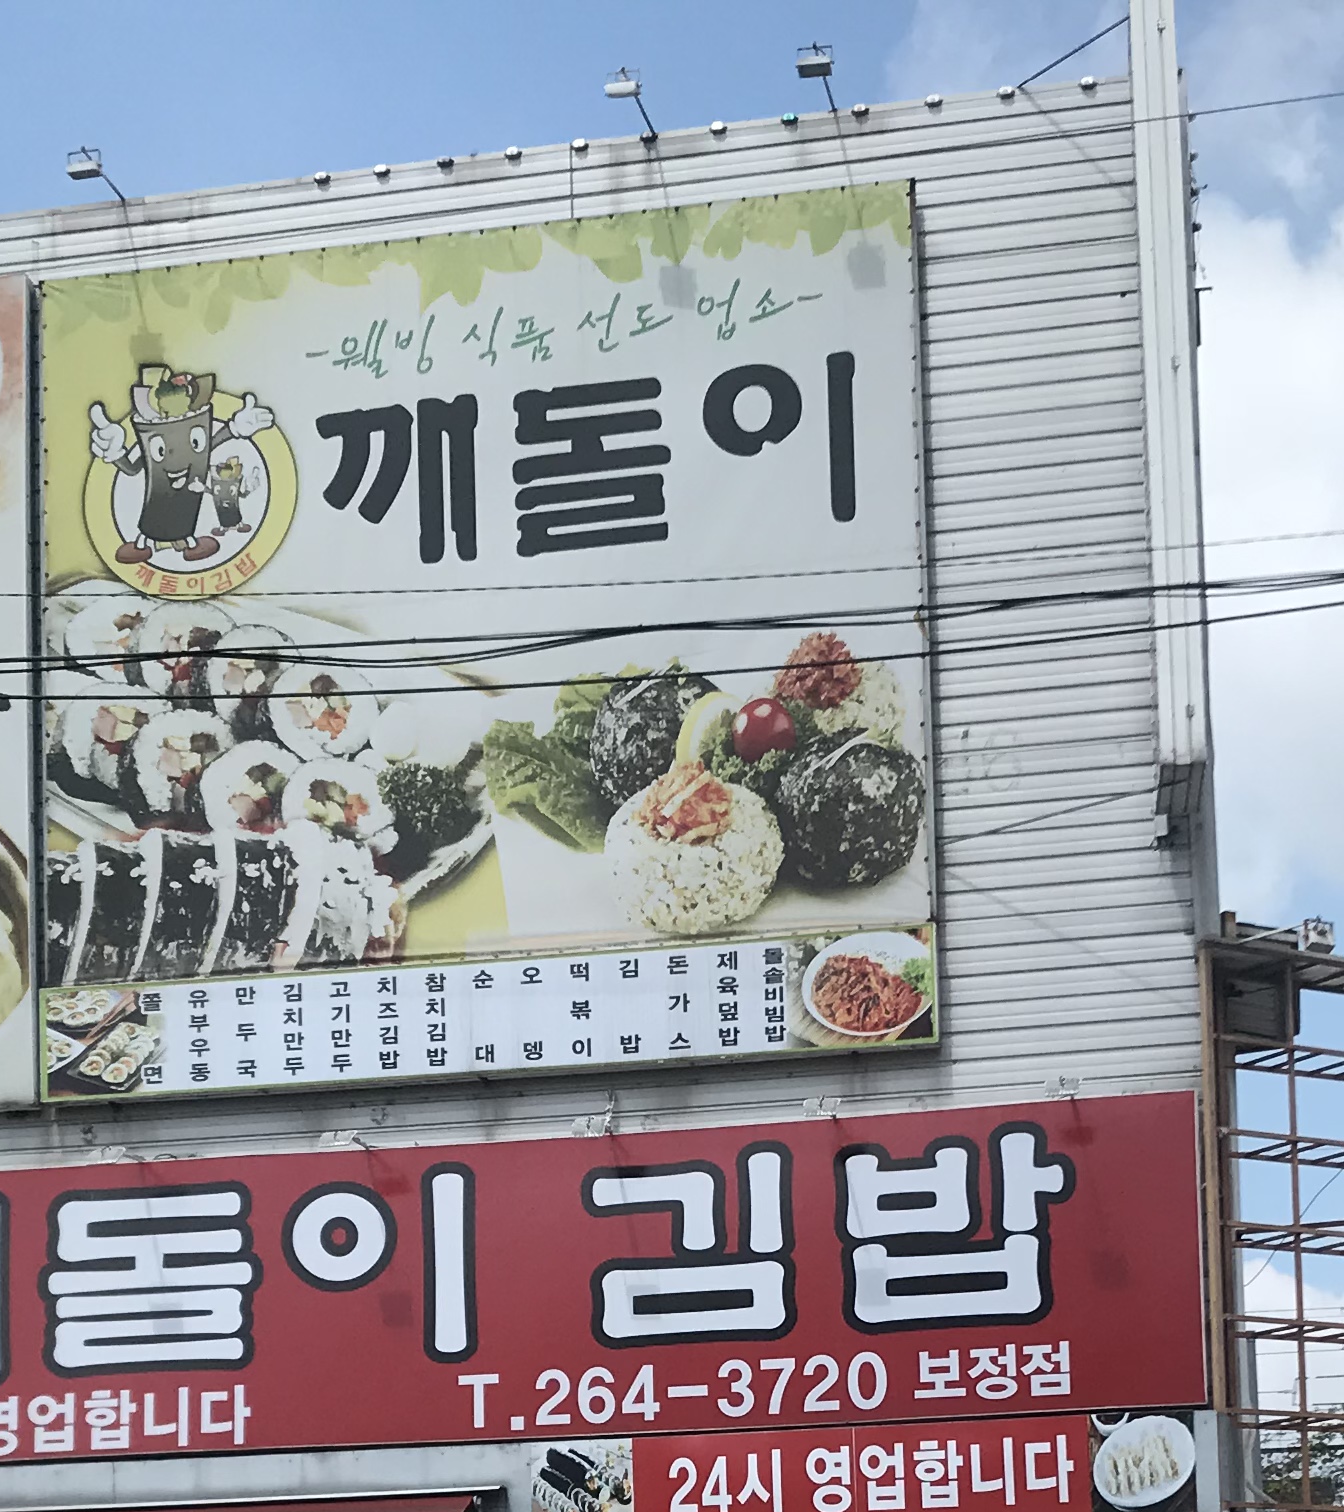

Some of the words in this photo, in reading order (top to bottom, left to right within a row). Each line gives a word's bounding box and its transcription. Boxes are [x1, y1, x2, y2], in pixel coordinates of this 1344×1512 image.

[462, 306, 556, 364] 식품
[577, 292, 670, 353] 선도
[316, 350, 855, 564] 깨돌이
[283, 983, 304, 1076] 김치만두
[330, 980, 352, 1074] 고기만두
[376, 975, 399, 1070] 치즈김밥
[424, 972, 446, 1066] 참치김밥
[581, 1121, 1074, 1348] 김밥
[457, 1348, 888, 1431] T.264-3720
[913, 1340, 1072, 1402] 보정점
